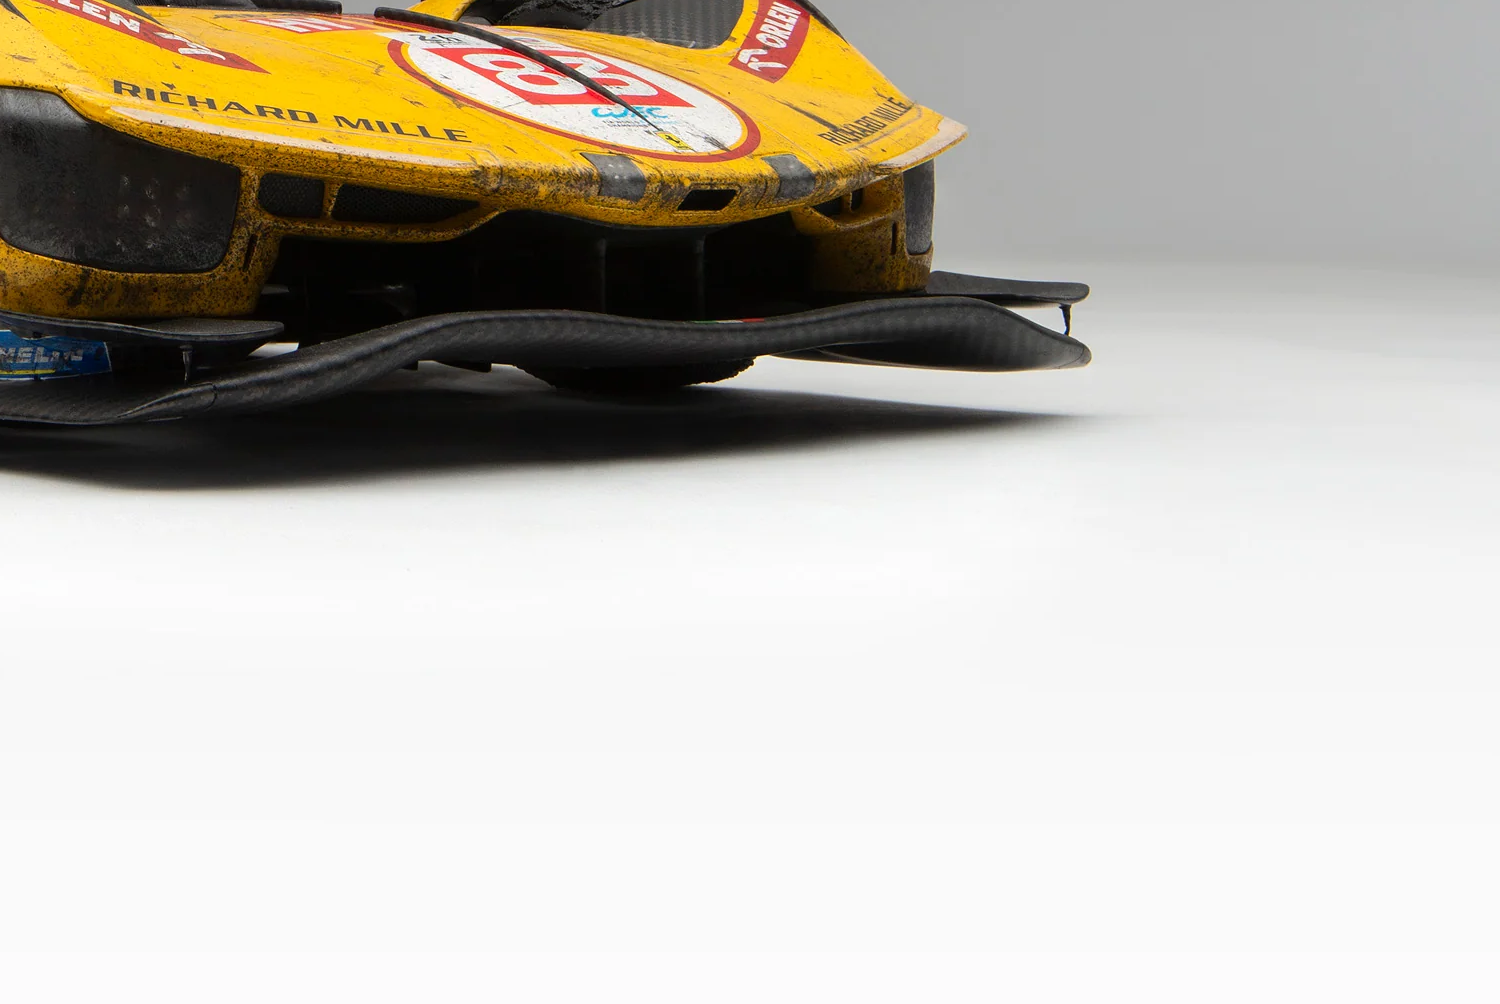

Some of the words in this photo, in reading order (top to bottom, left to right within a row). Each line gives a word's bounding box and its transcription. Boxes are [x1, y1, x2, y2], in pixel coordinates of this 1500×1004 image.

[755, 1, 802, 49] ORLEN
[461, 53, 659, 97] 83
[113, 79, 319, 124] RICHARD
[333, 114, 473, 143] MILLE
[817, 115, 888, 147] RICHARD
[869, 96, 913, 123] MILLE
